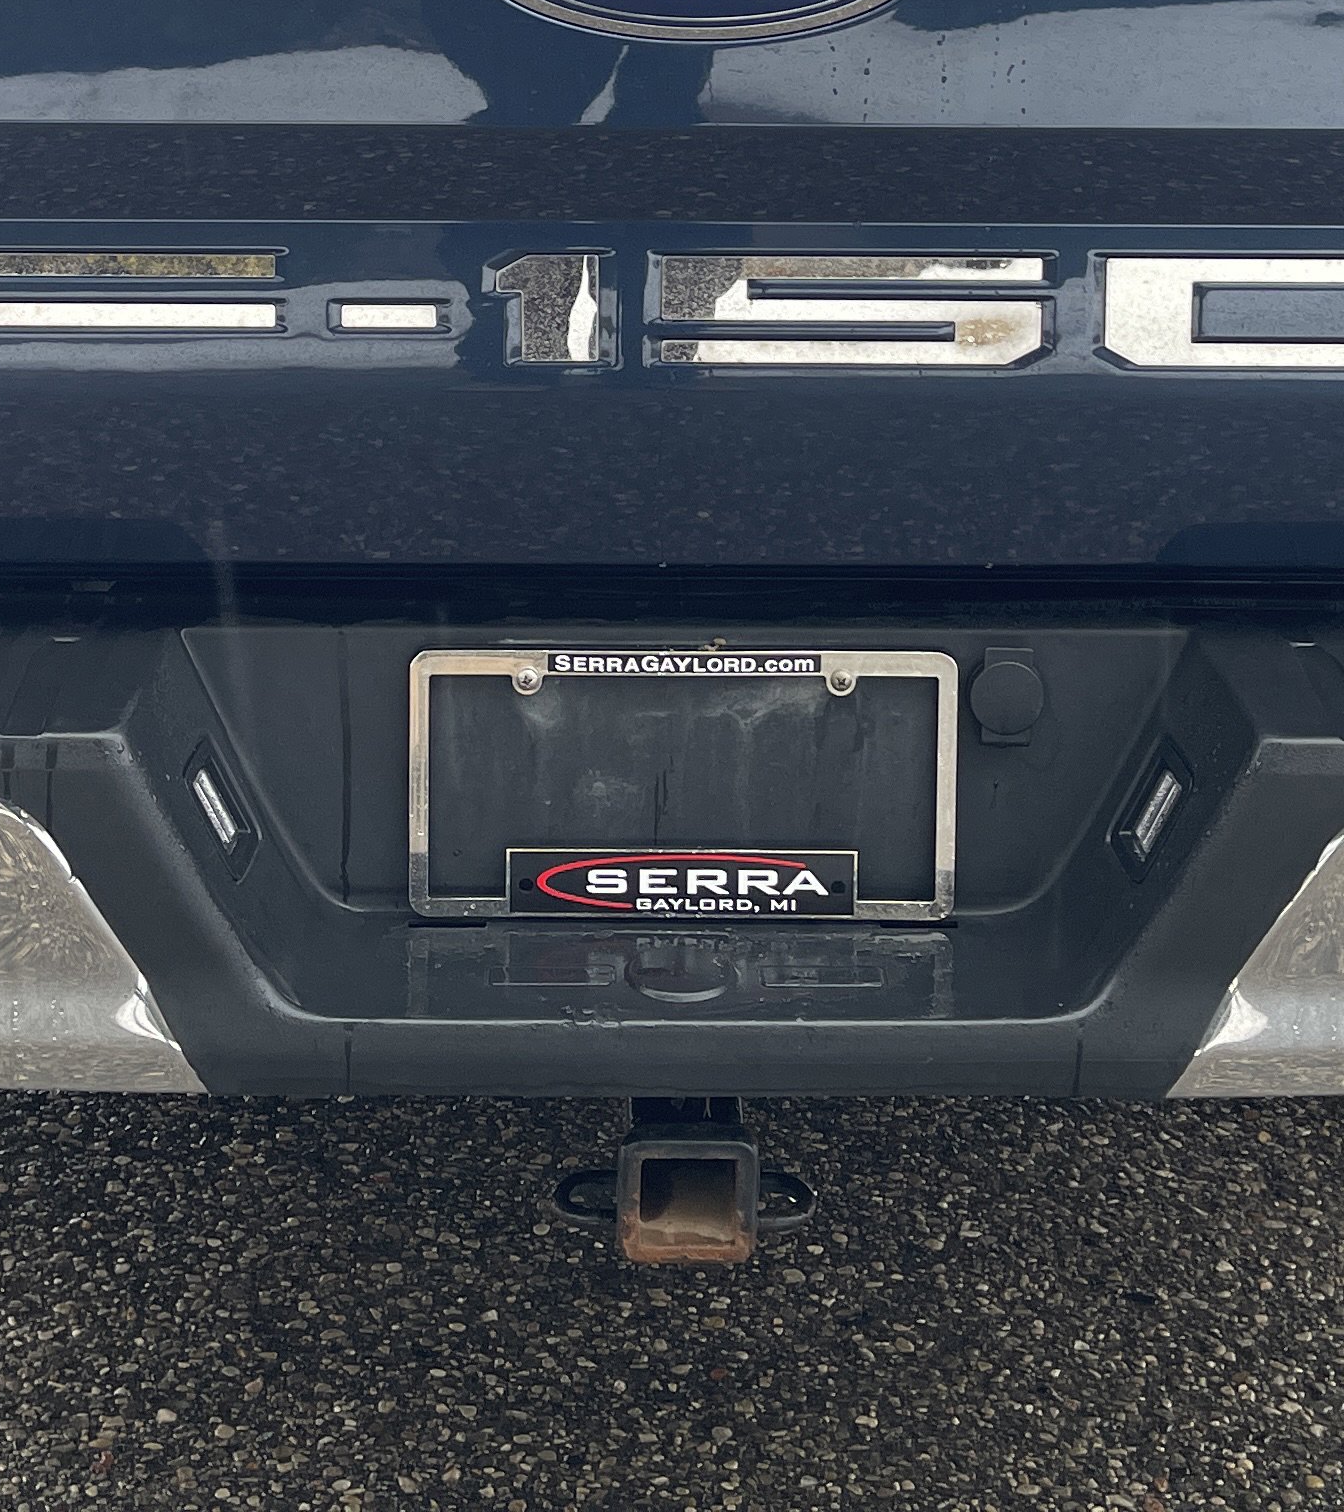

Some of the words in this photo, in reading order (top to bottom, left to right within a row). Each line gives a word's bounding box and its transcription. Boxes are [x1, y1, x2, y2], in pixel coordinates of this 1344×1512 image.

[554, 654, 816, 673] SERRAGAYLORD.com
[585, 868, 829, 896] SERRA
[635, 897, 761, 913] GAYLORD,
[770, 898, 797, 912] MI
